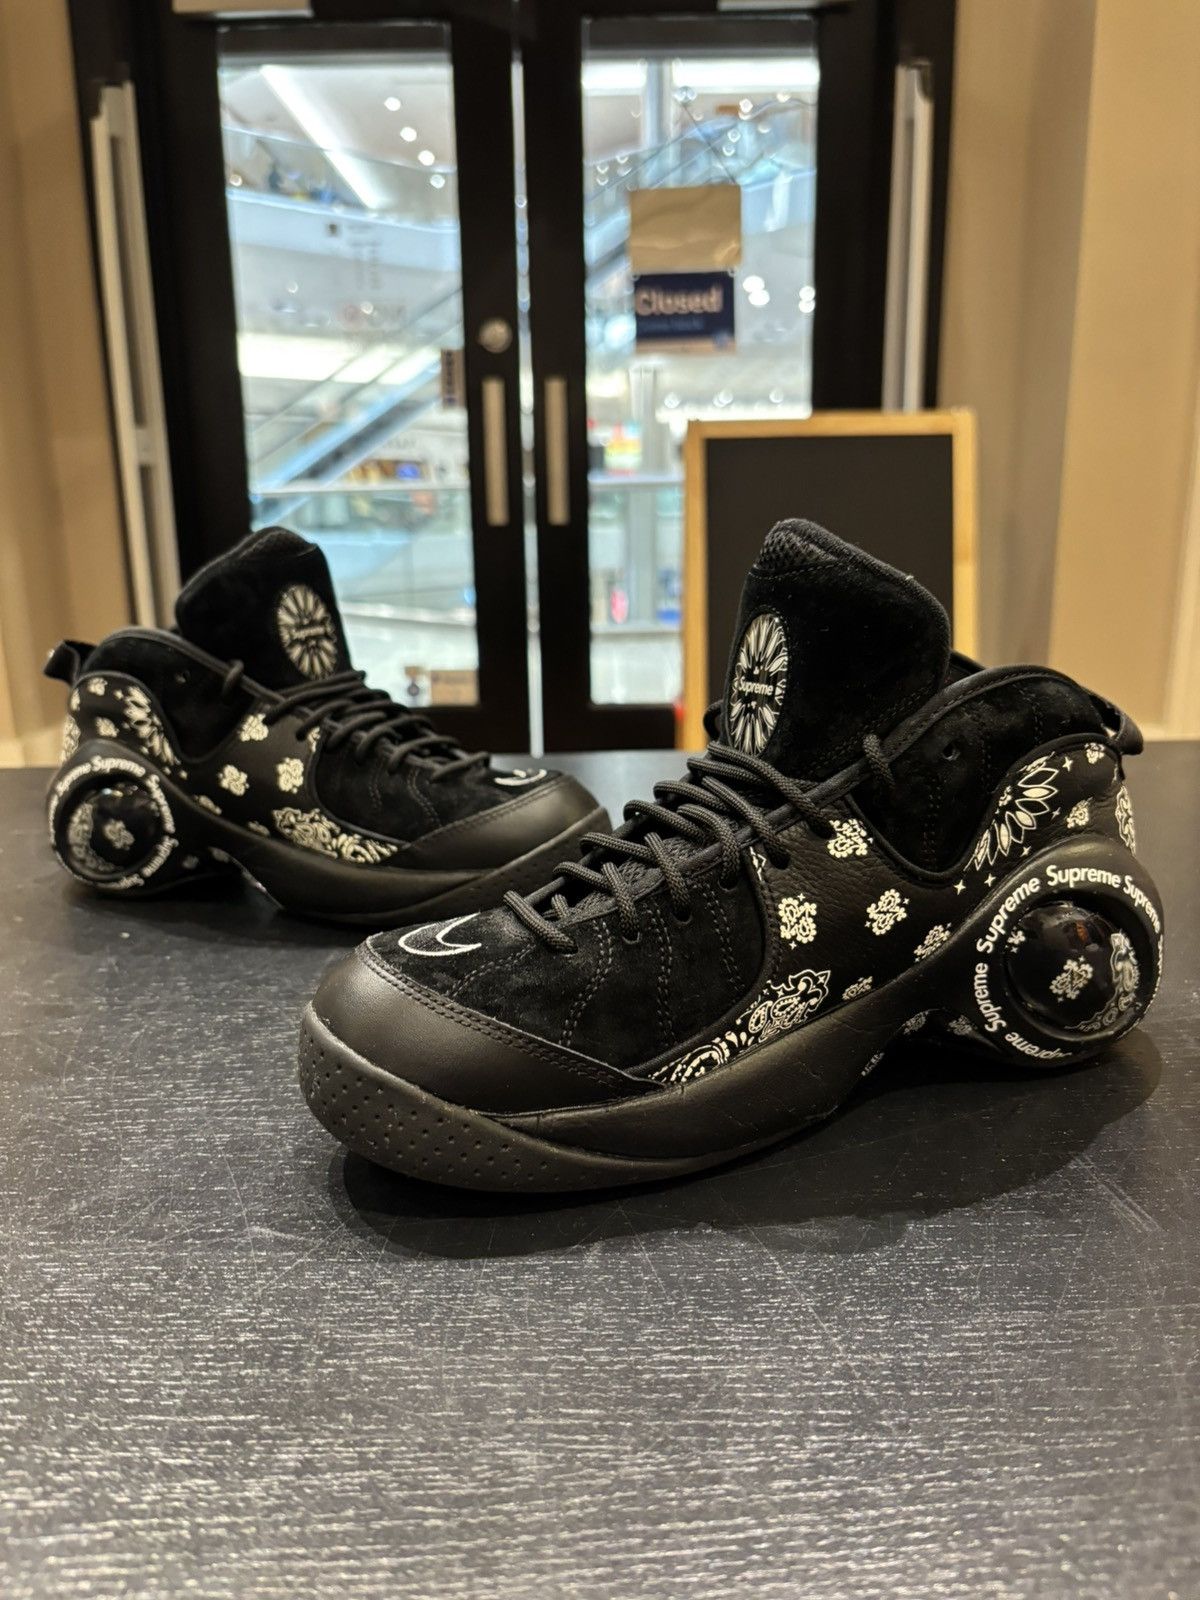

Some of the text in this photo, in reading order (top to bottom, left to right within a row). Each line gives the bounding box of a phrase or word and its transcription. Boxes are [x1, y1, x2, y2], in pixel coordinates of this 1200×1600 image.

[635, 285, 723, 316] Closed
[738, 676, 774, 697] Supreme
[1045, 864, 1122, 889] Supreme
[976, 876, 1042, 954] Supreme
[1122, 875, 1162, 934] Supreme
[973, 962, 1007, 1033] Supreme
